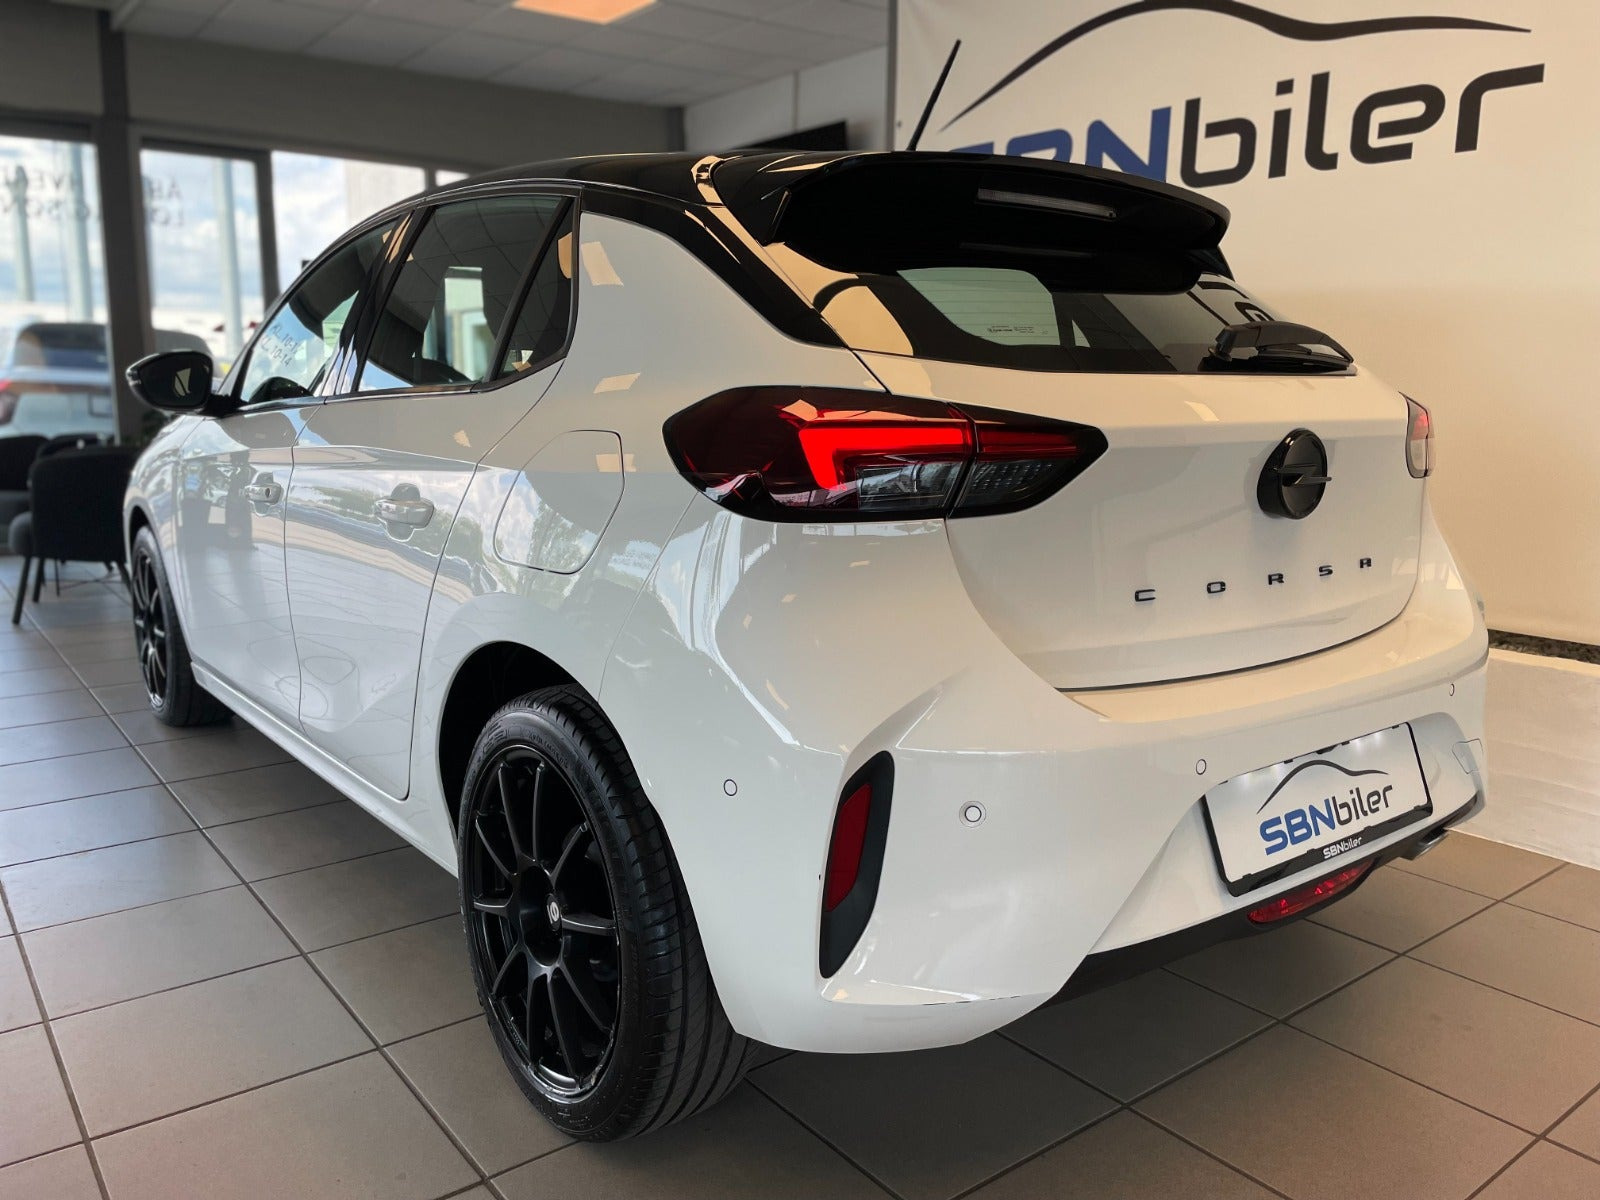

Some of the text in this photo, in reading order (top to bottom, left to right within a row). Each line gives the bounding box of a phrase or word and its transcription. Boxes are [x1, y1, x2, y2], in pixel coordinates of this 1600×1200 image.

[1134, 557, 1372, 602] CORSA
[1259, 785, 1393, 856] SBNbiler
[1323, 836, 1362, 859] SBNbiler
